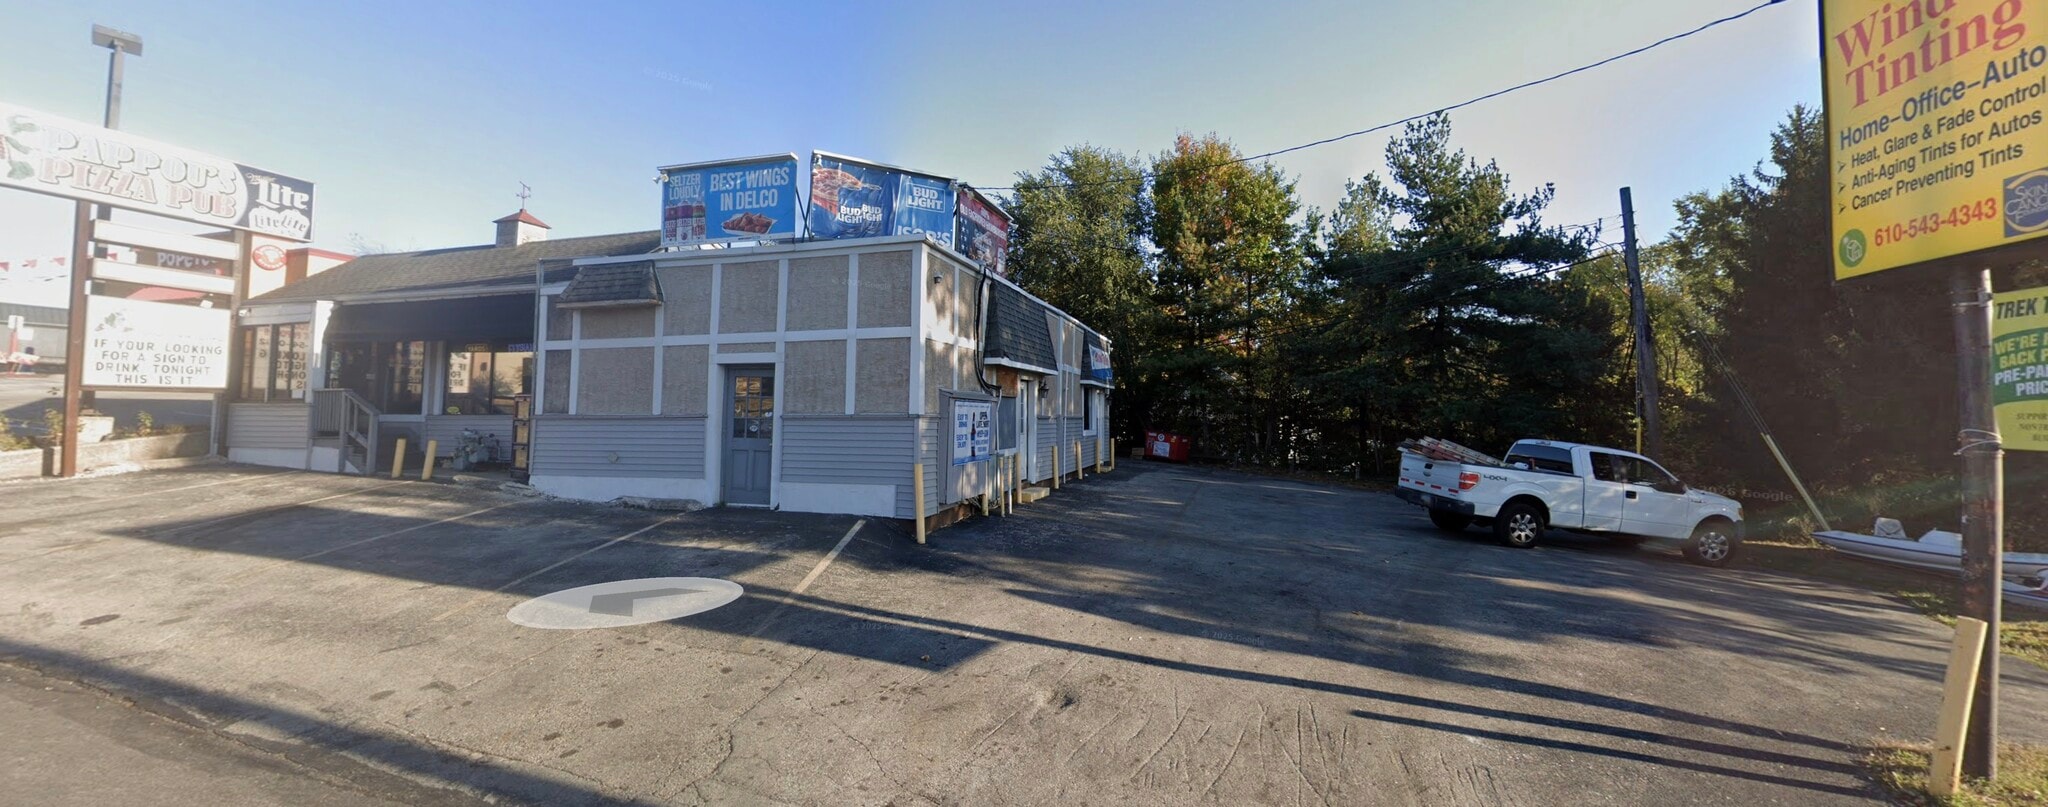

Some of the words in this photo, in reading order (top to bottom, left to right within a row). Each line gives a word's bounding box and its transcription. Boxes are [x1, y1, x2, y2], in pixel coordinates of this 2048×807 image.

[1845, 0, 2026, 109] Tinting
[1851, 149, 1880, 169] Heat,
[1884, 130, 1918, 156] Glare
[1922, 124, 1933, 141] &
[1937, 107, 1975, 135] Fade
[1980, 76, 2047, 117] Control
[41, 126, 236, 194] PAPPOU'S
[1852, 153, 1916, 190] Anti-Aging
[1920, 140, 1956, 165] Tints
[1961, 131, 1983, 151] for
[1989, 110, 2042, 141] Autos
[38, 156, 158, 204] PIZZA
[165, 183, 236, 218] PUB
[669, 172, 701, 188] SELTZER
[710, 171, 743, 192] BEST
[745, 166, 790, 189] WINGS
[1852, 184, 1892, 210] Cancer
[1896, 159, 1975, 196] Preventing
[1979, 143, 2023, 169] Tints
[254, 178, 310, 210] Lite
[720, 191, 733, 211] IN
[736, 188, 778, 211] DELCO
[907, 195, 943, 210] LIGHT
[912, 186, 938, 199] BUD
[837, 211, 862, 224] LIGHT
[840, 205, 861, 216] BUD
[862, 203, 881, 214] BUD
[862, 211, 883, 222] IGHT
[1874, 196, 1997, 247] 610-543-4343
[1996, 297, 2039, 320] TREK
[94, 338, 108, 348] IF
[117, 340, 155, 351] YOUR
[165, 343, 222, 355] LOOKING
[1994, 333, 2039, 356] WE'RE
[96, 361, 139, 373] DRINK
[153, 364, 211, 375] TONIGHT
[102, 350, 129, 361] FOR
[138, 352, 146, 361] A
[154, 353, 185, 364] SIGN
[190, 355, 207, 365] TO
[2000, 350, 2036, 370] BACK
[115, 373, 147, 384] THIS
[159, 375, 172, 385] IS
[180, 376, 193, 385] IT
